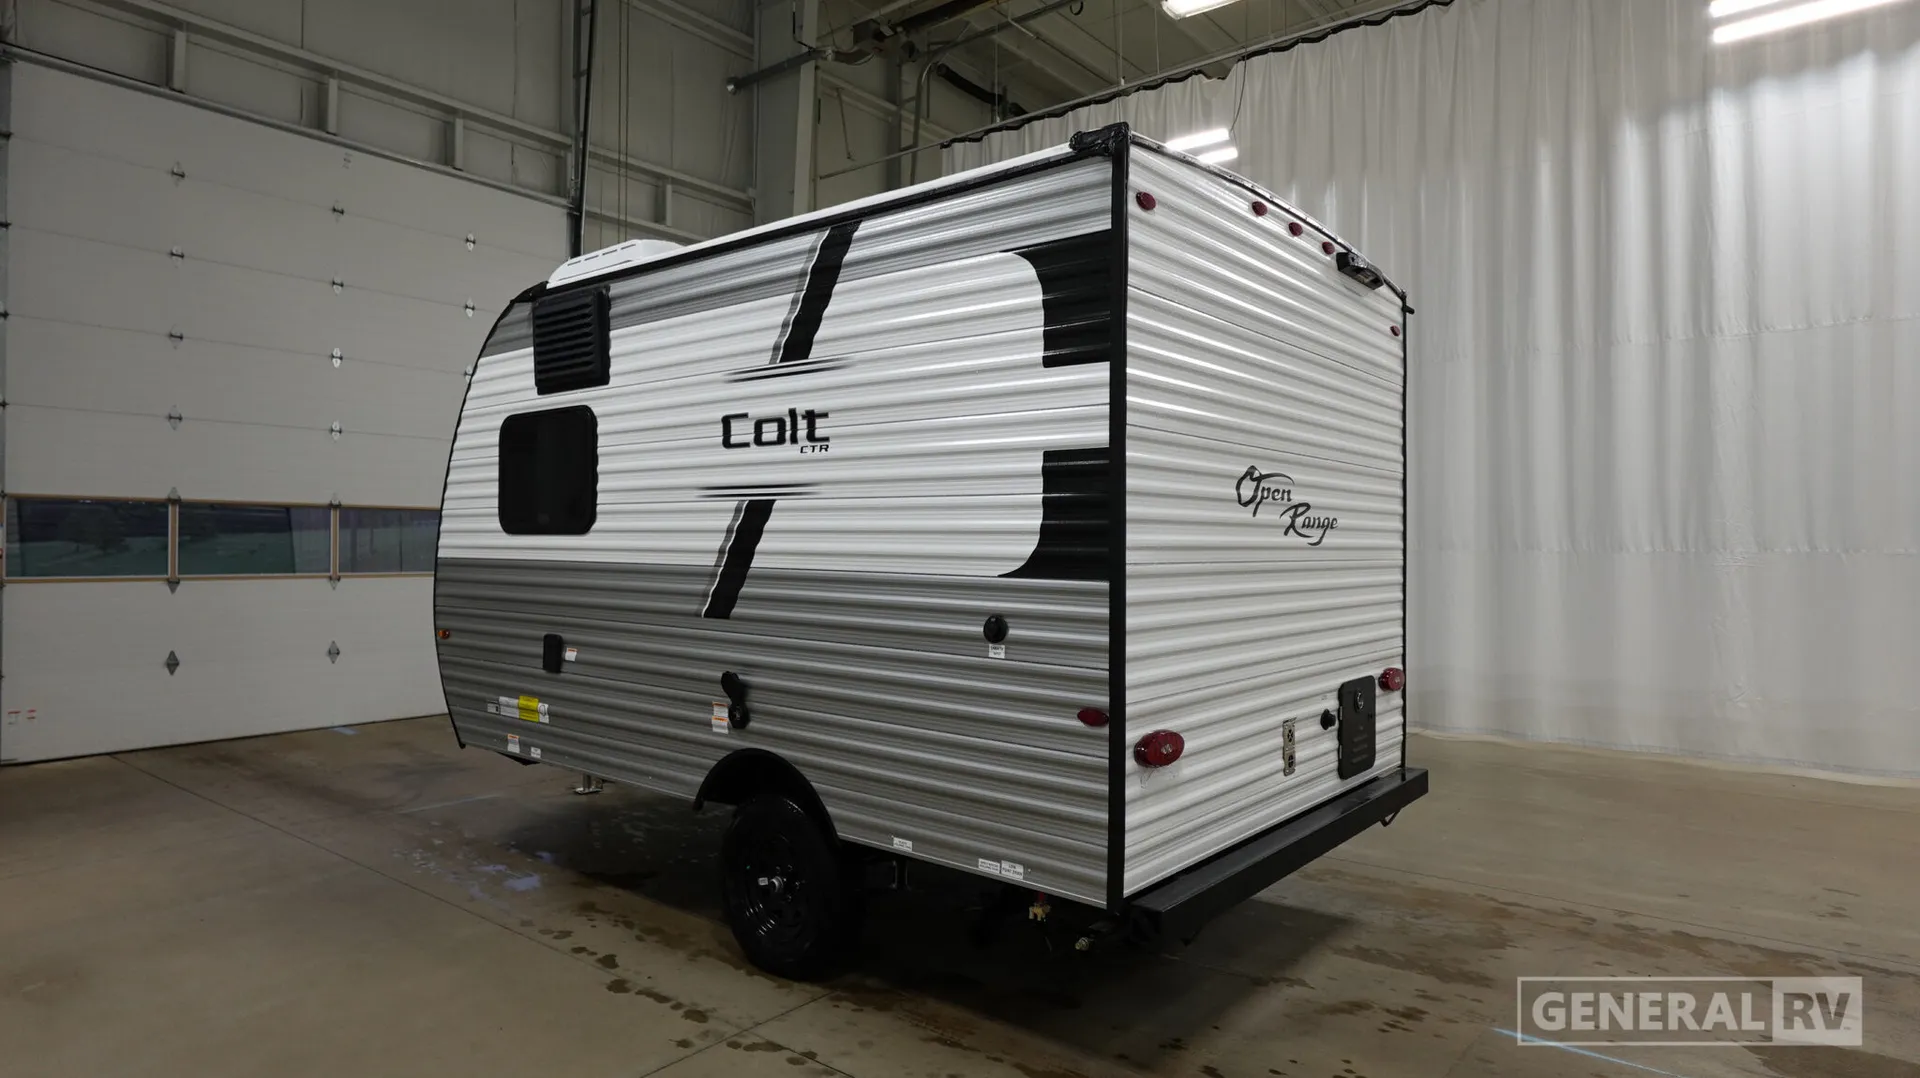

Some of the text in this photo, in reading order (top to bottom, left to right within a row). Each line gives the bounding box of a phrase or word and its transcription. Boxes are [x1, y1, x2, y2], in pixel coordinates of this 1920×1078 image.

[721, 407, 831, 449] Colt
[800, 444, 830, 454] CTR
[1235, 465, 1295, 518] Open
[1279, 502, 1338, 547] Range
